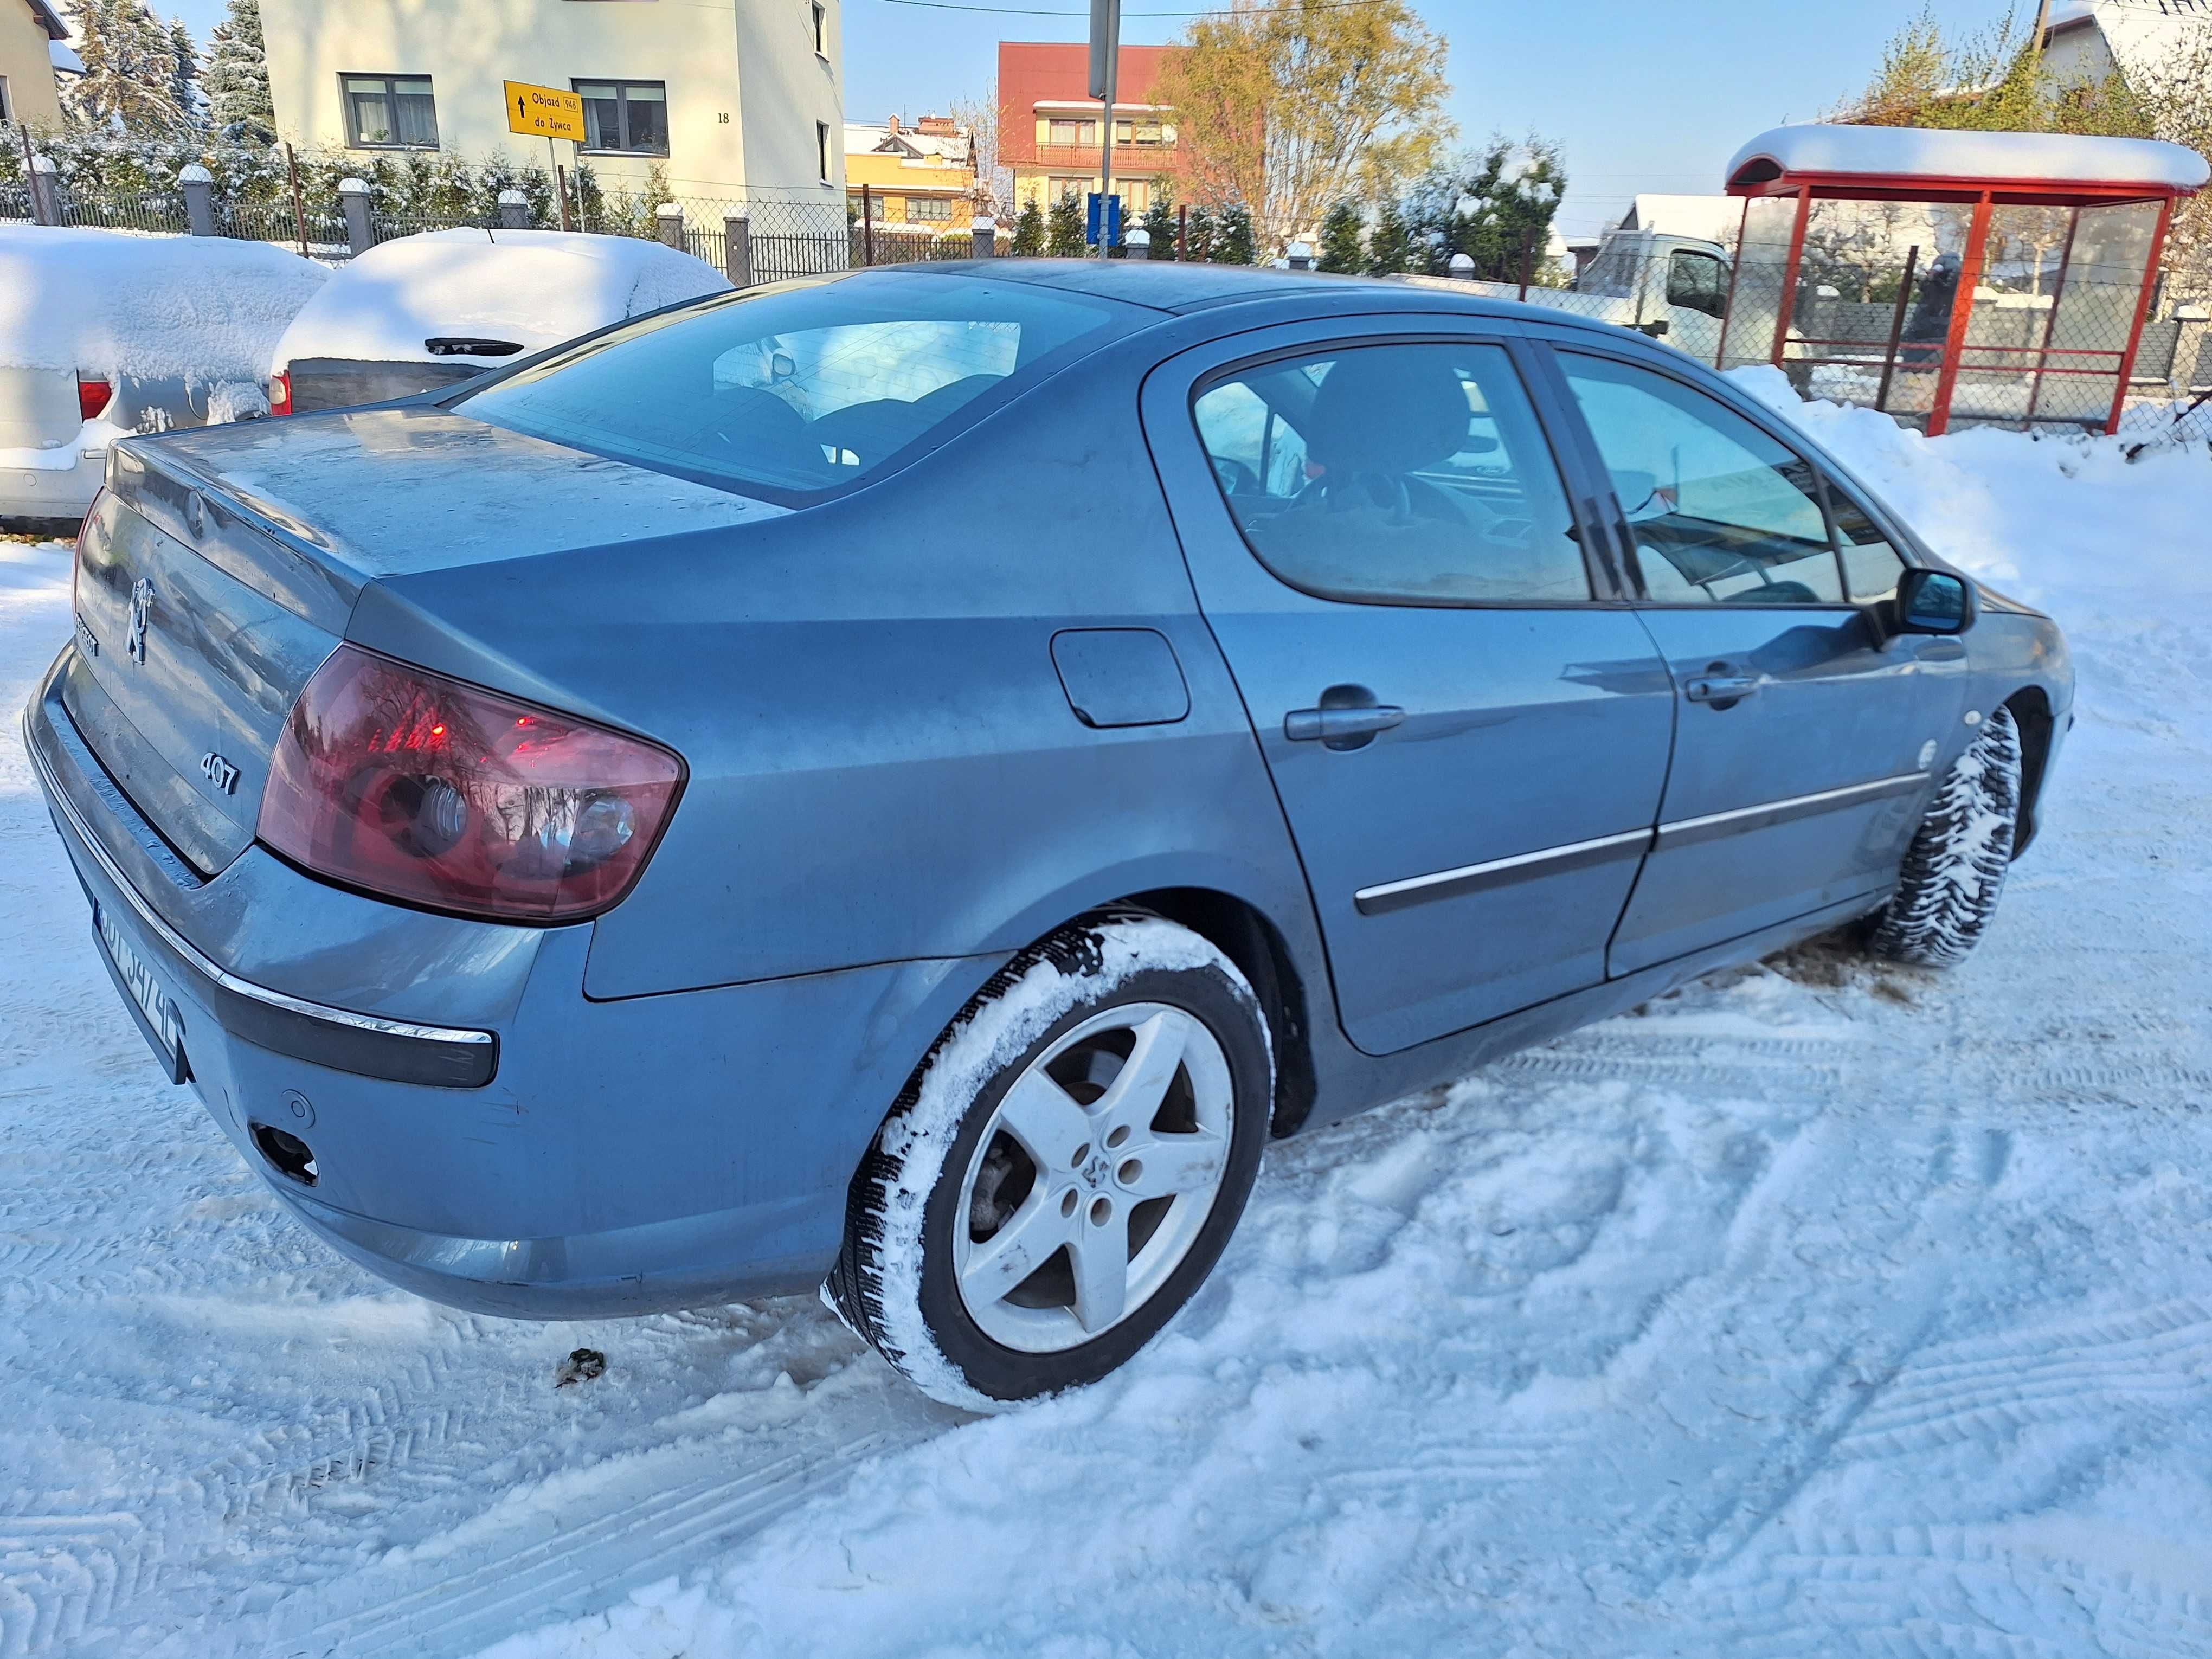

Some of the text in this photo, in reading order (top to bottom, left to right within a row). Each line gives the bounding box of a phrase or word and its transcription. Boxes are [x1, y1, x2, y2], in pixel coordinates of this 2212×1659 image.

[532, 92, 576, 110] Objazd 948
[535, 115, 571, 132] do Żywca
[717, 112, 729, 124] 18
[200, 752, 240, 795] 407
